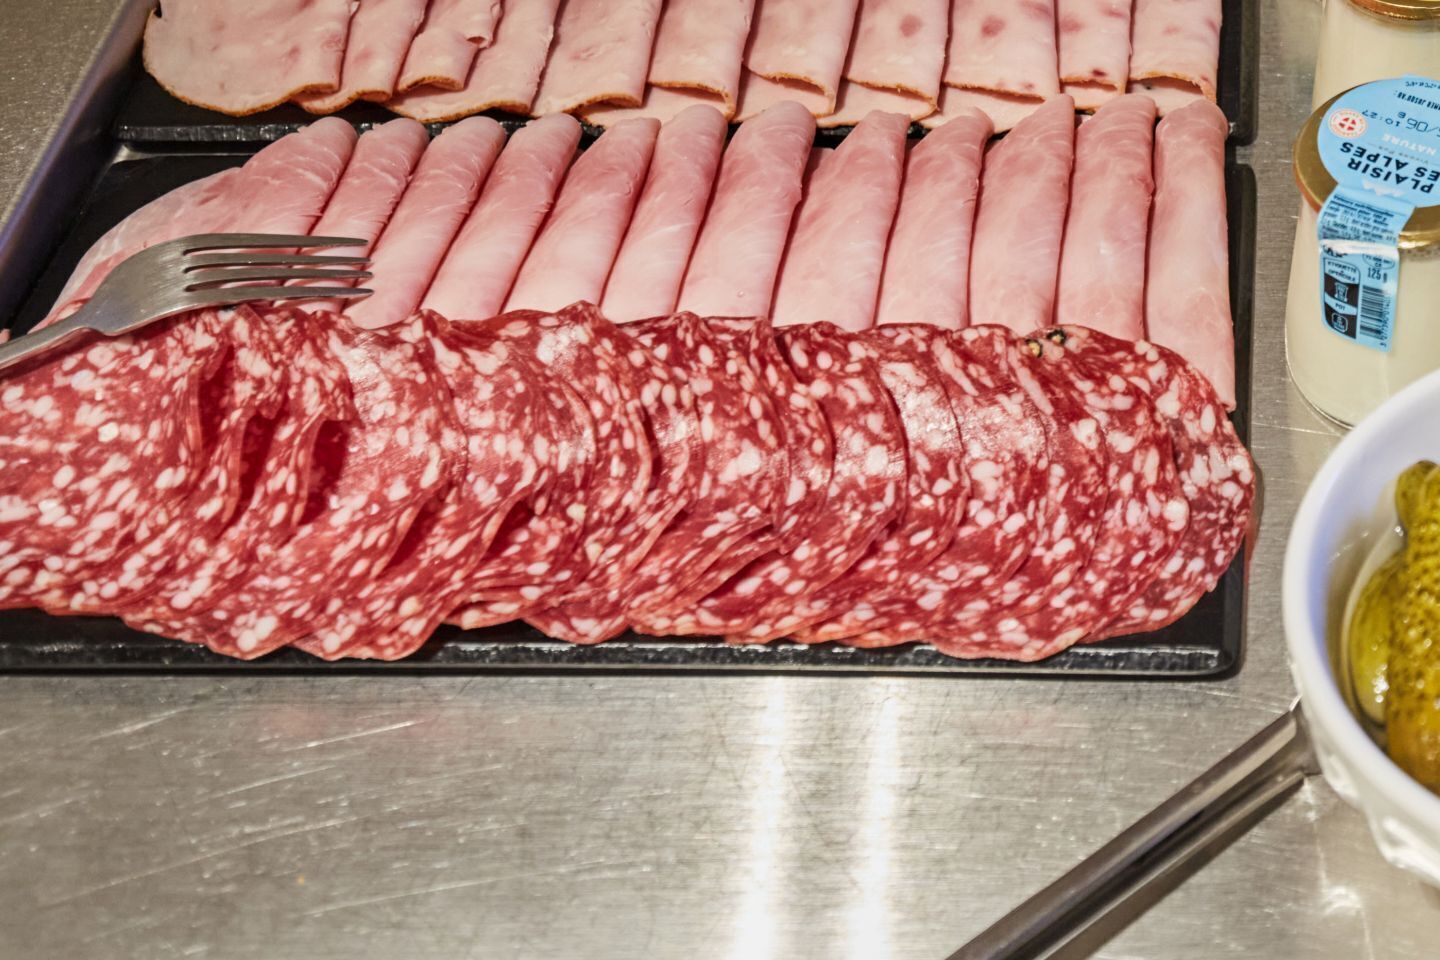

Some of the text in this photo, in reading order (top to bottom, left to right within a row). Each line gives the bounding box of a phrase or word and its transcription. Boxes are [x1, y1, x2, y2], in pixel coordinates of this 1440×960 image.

[1340, 142, 1409, 171] ALPES
[1382, 133, 1436, 156] NATURE
[1347, 158, 1434, 194] PLAISIR
